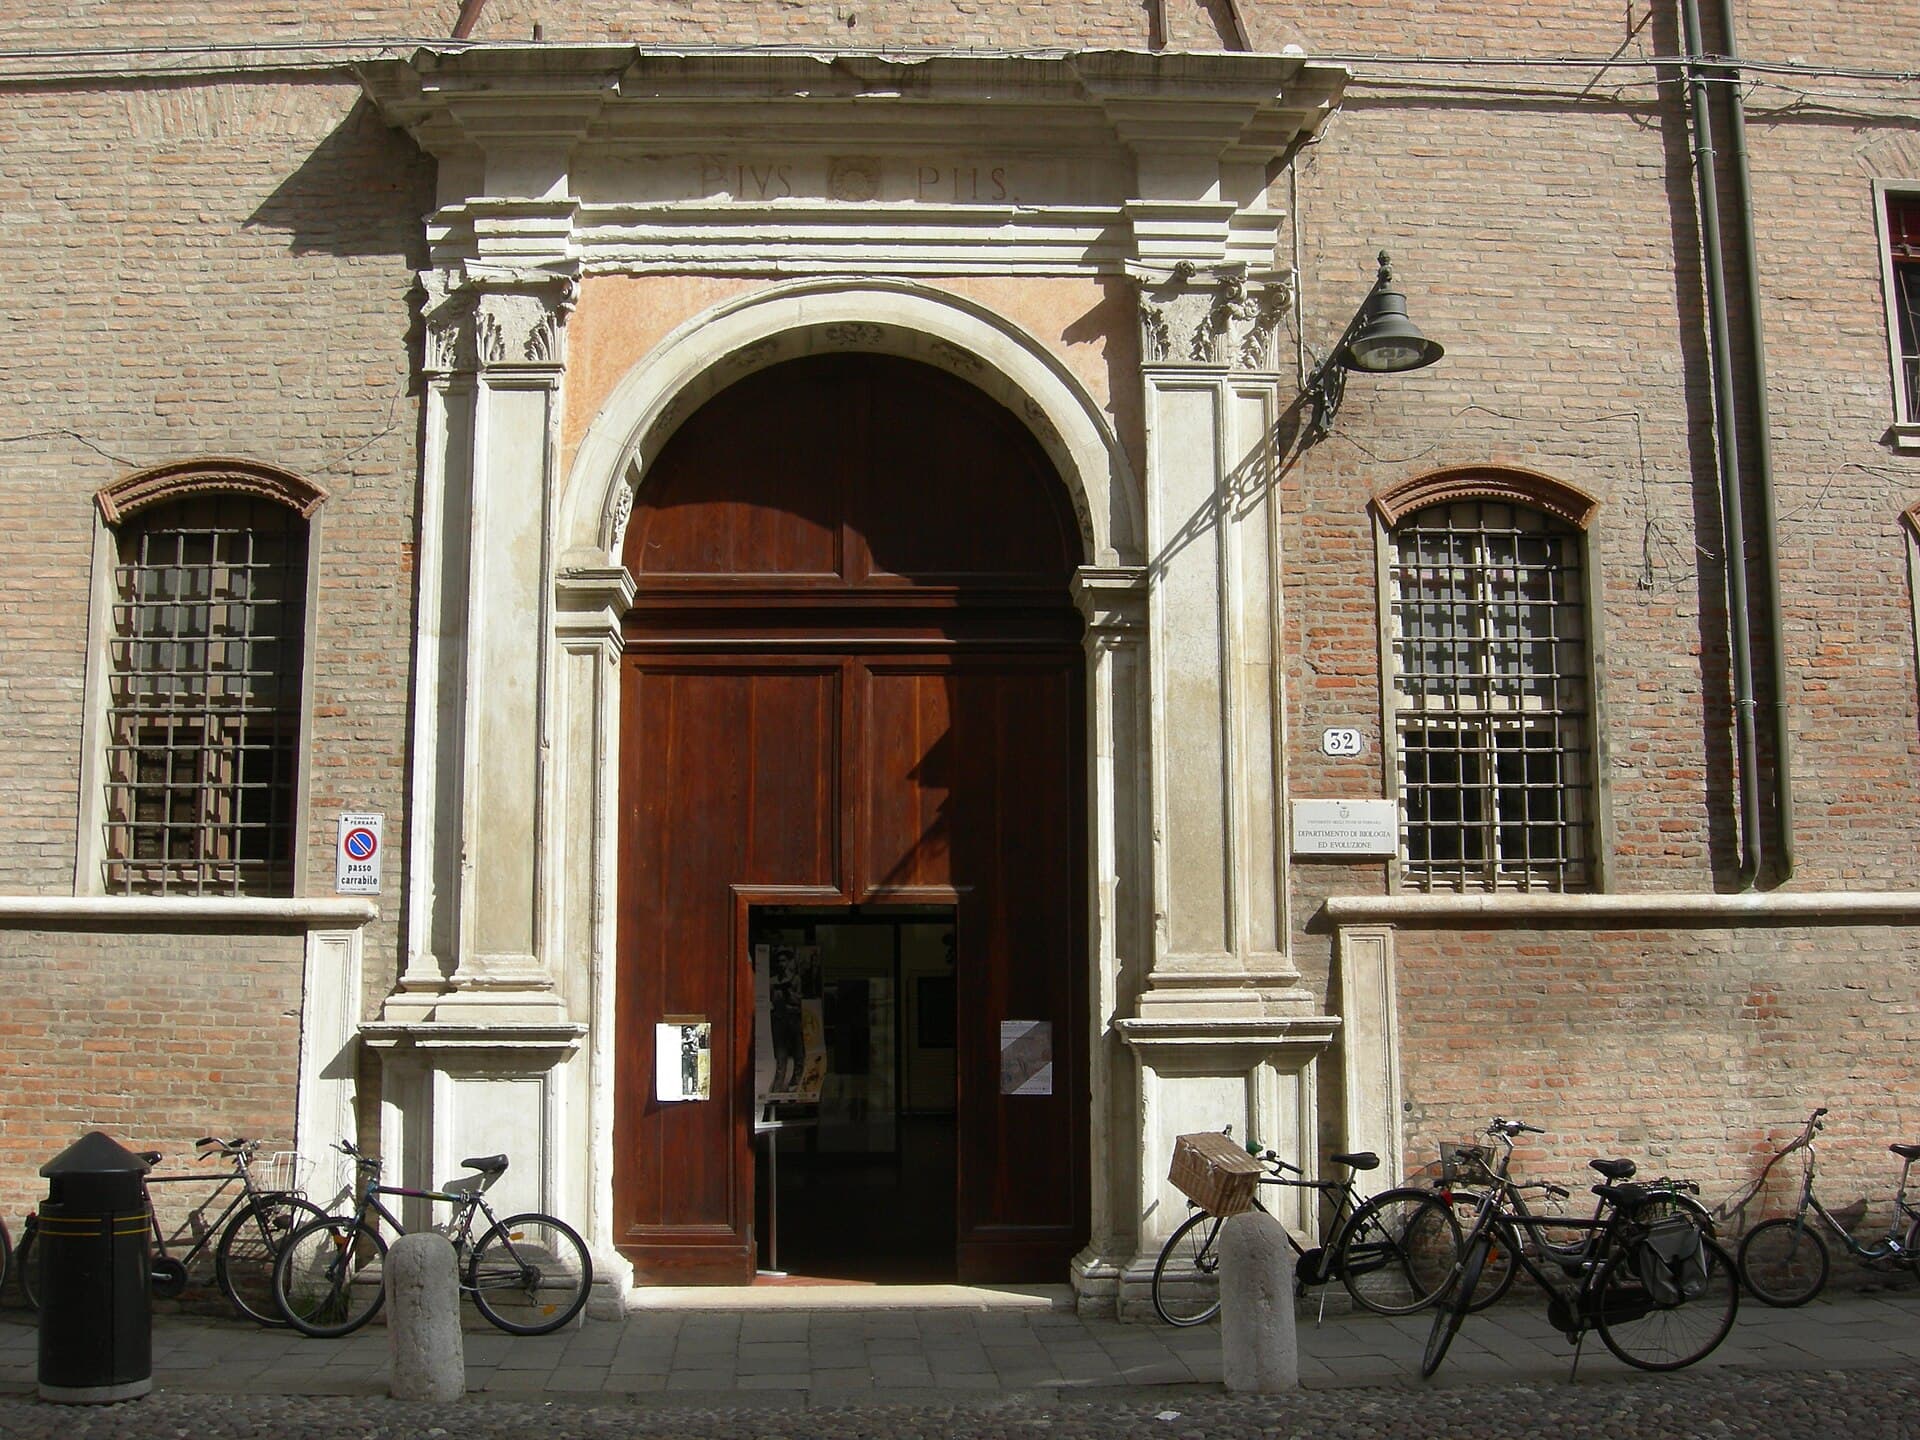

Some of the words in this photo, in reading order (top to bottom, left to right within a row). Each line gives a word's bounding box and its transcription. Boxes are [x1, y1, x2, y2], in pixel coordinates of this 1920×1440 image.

[1330, 732, 1353, 750] 32
[1298, 830, 1349, 838] DIPARTIMENTO
[1350, 830, 1357, 838] DI
[1359, 830, 1391, 838] BIOLOGIA
[1318, 841, 1328, 849] ED
[1330, 841, 1372, 849] EVOLUZIONE
[347, 864, 372, 873] passo
[341, 875, 378, 885] carrabile
